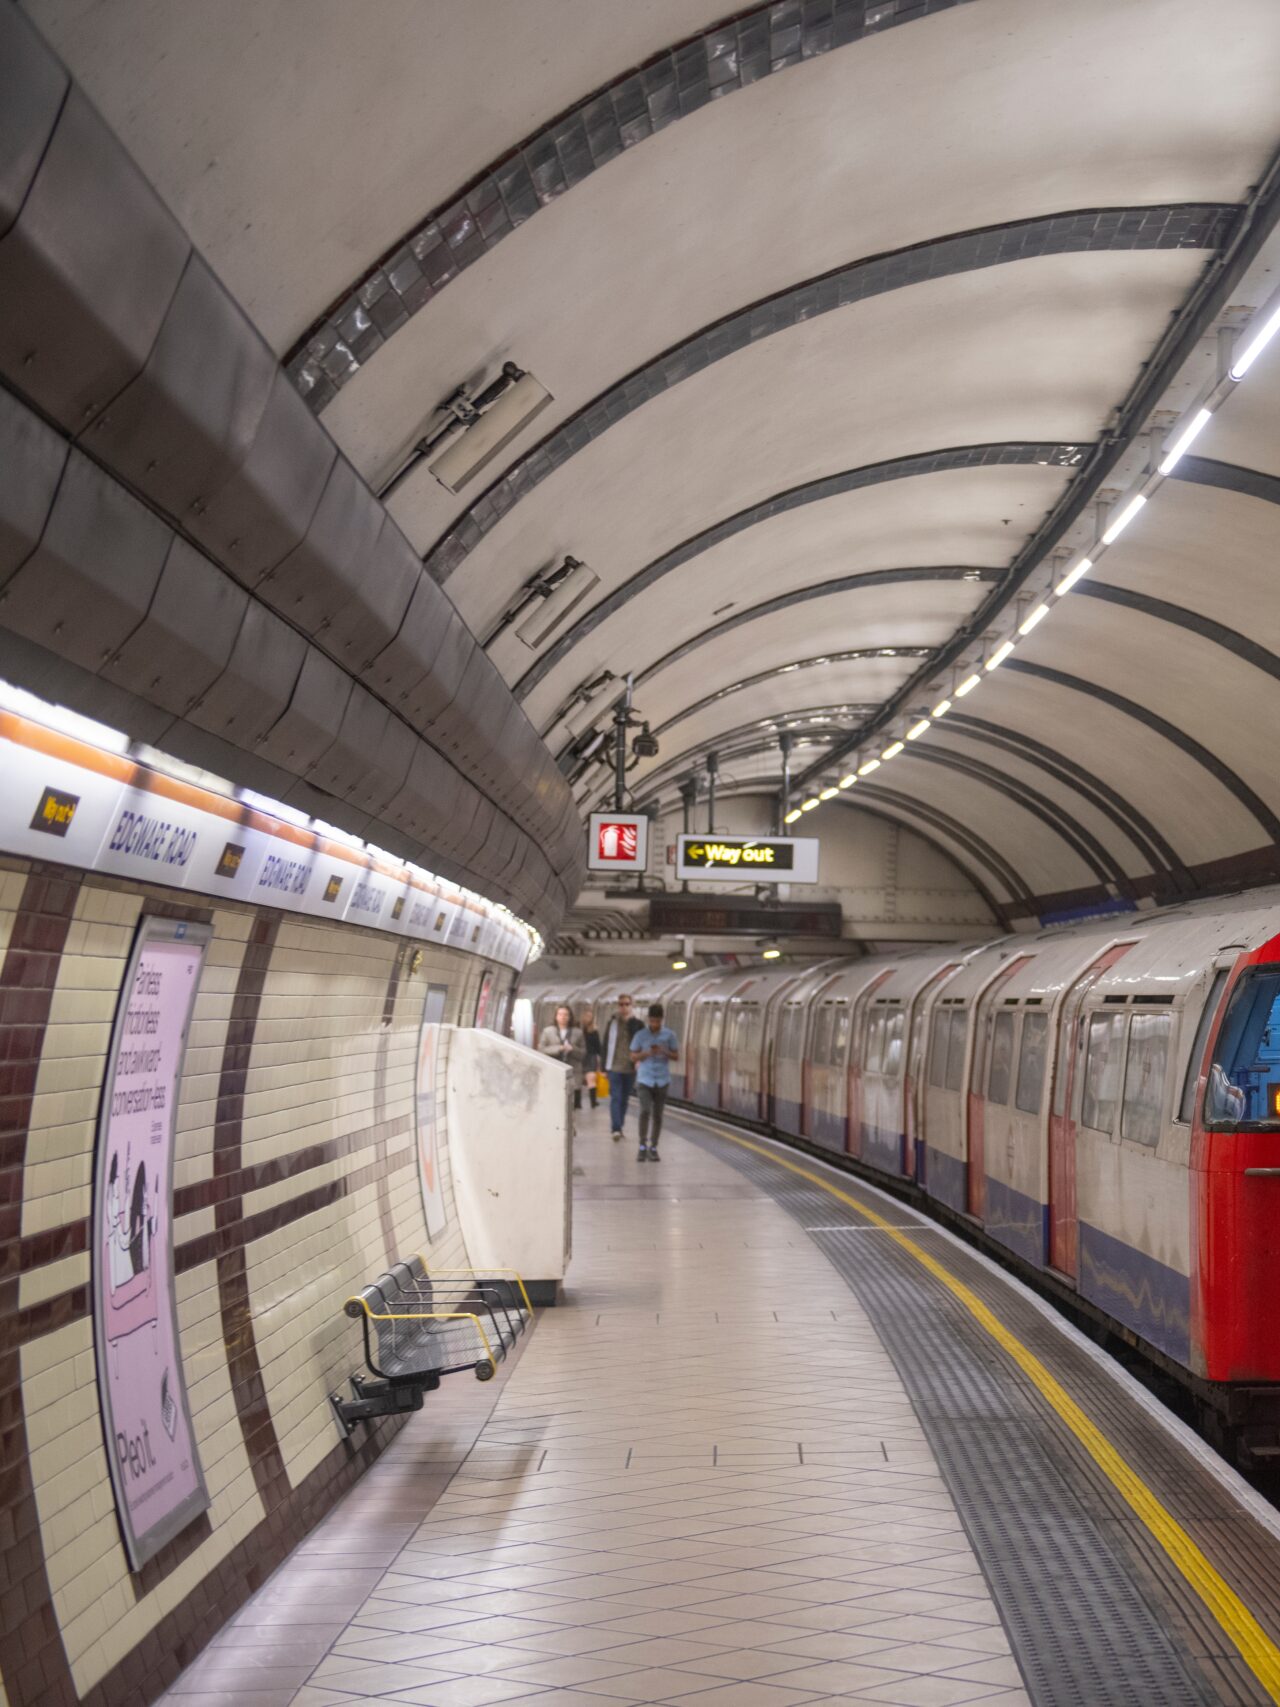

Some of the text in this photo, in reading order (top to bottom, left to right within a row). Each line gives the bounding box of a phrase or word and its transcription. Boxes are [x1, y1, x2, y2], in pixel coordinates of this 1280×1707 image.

[109, 810, 197, 866] EDGWARE ROAD
[704, 844, 775, 865] Way out
[116, 1429, 147, 1487] Pleo
